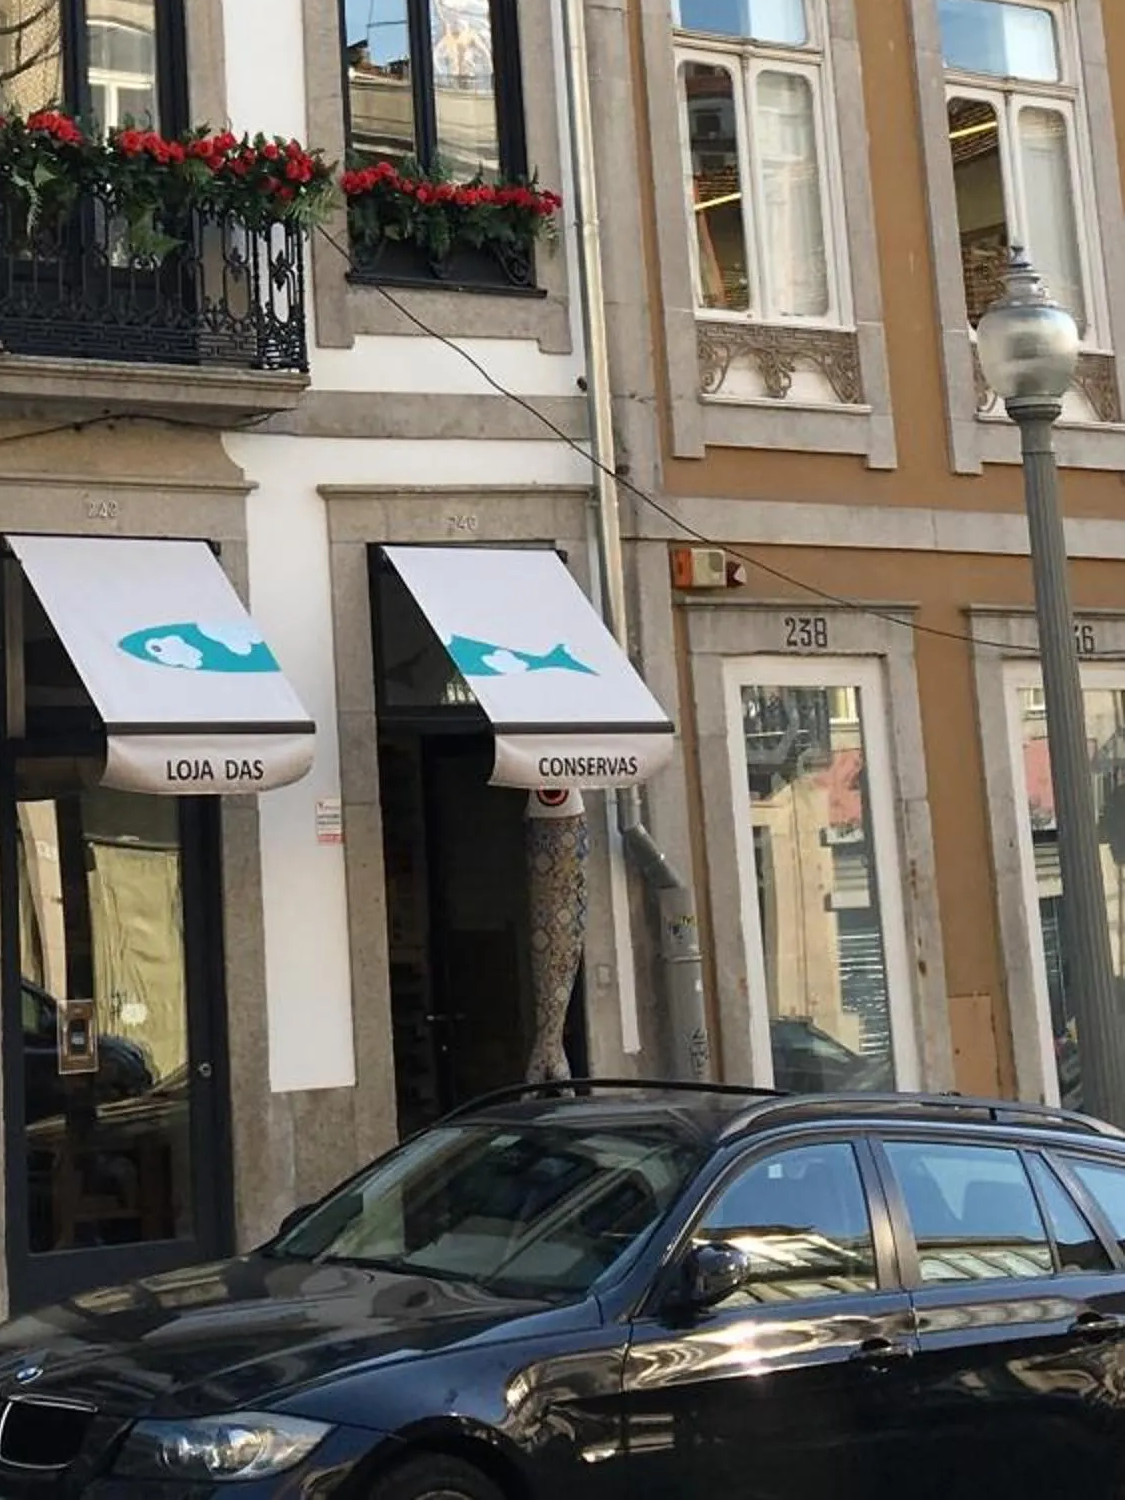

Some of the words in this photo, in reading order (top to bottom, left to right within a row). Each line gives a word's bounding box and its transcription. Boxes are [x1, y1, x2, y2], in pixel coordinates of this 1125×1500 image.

[784, 616, 828, 647] 238
[166, 759, 215, 781] LOJA
[225, 759, 264, 781] DAS
[538, 756, 638, 777] CONSERVAS
